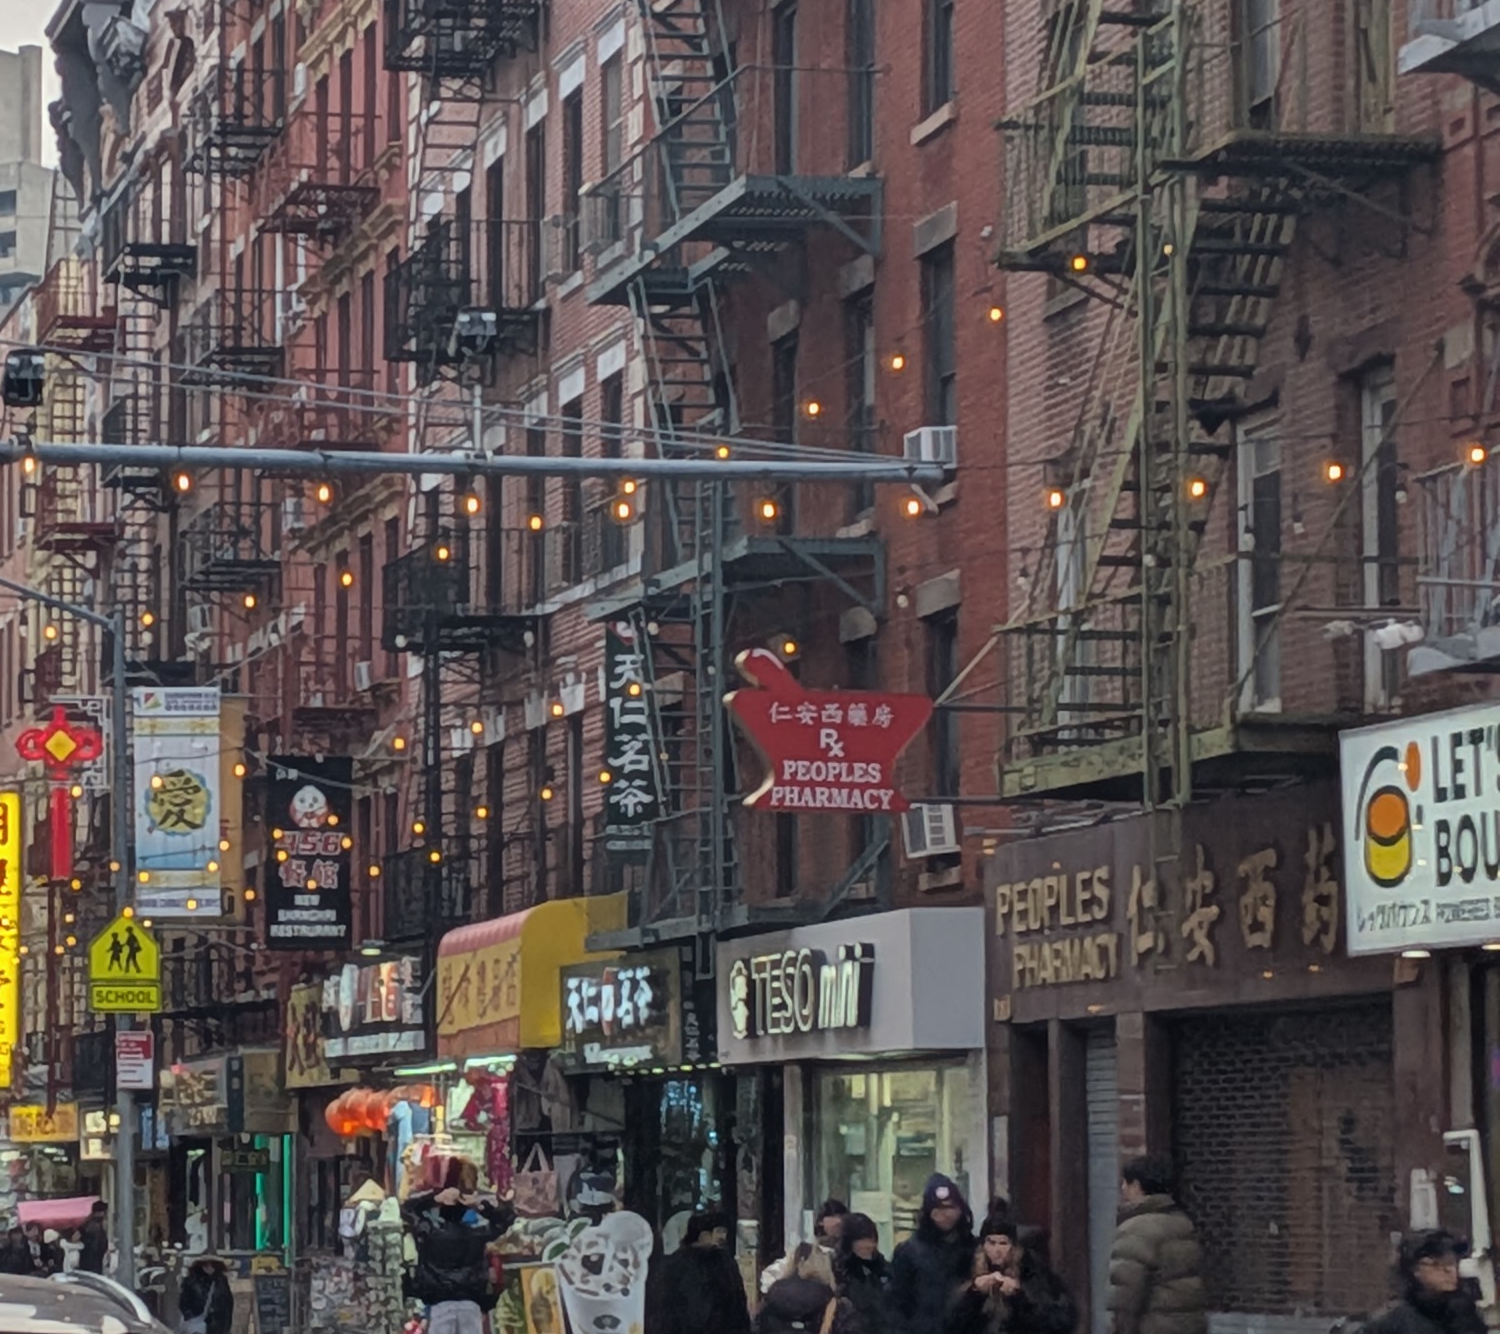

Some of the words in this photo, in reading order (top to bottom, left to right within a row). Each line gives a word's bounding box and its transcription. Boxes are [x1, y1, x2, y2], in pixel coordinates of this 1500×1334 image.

[608, 654, 653, 817] 天仁茗茶
[1430, 723, 1500, 804] LET'
[152, 769, 203, 830] 愛
[769, 786, 894, 810] PHARMACY
[782, 759, 882, 784] PEOPLES
[995, 866, 1111, 936] PEOPLES
[750, 947, 815, 1037] TESO
[817, 941, 864, 1030] mini
[1012, 931, 1120, 990] PHARMACY
[95, 990, 156, 1004] SCHOOL
